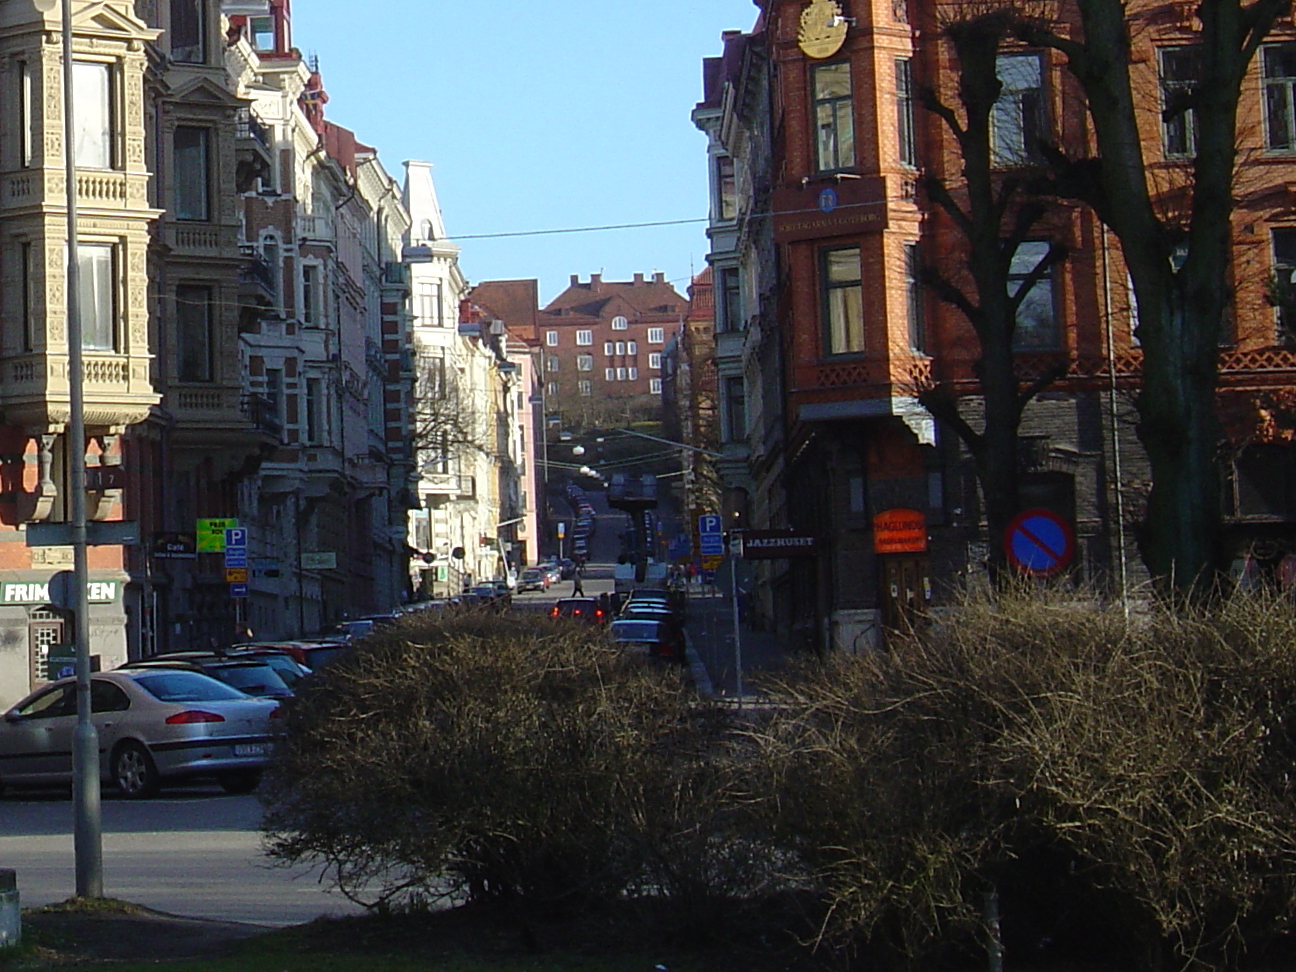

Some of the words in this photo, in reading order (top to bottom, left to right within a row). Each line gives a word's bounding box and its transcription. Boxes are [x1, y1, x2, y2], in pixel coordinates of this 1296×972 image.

[706, 517, 716, 532] P
[231, 529, 242, 545] P
[746, 537, 814, 548] JAZZHUSET
[166, 543, 184, 551] Café
[4, 582, 116, 602] FRIMEN
